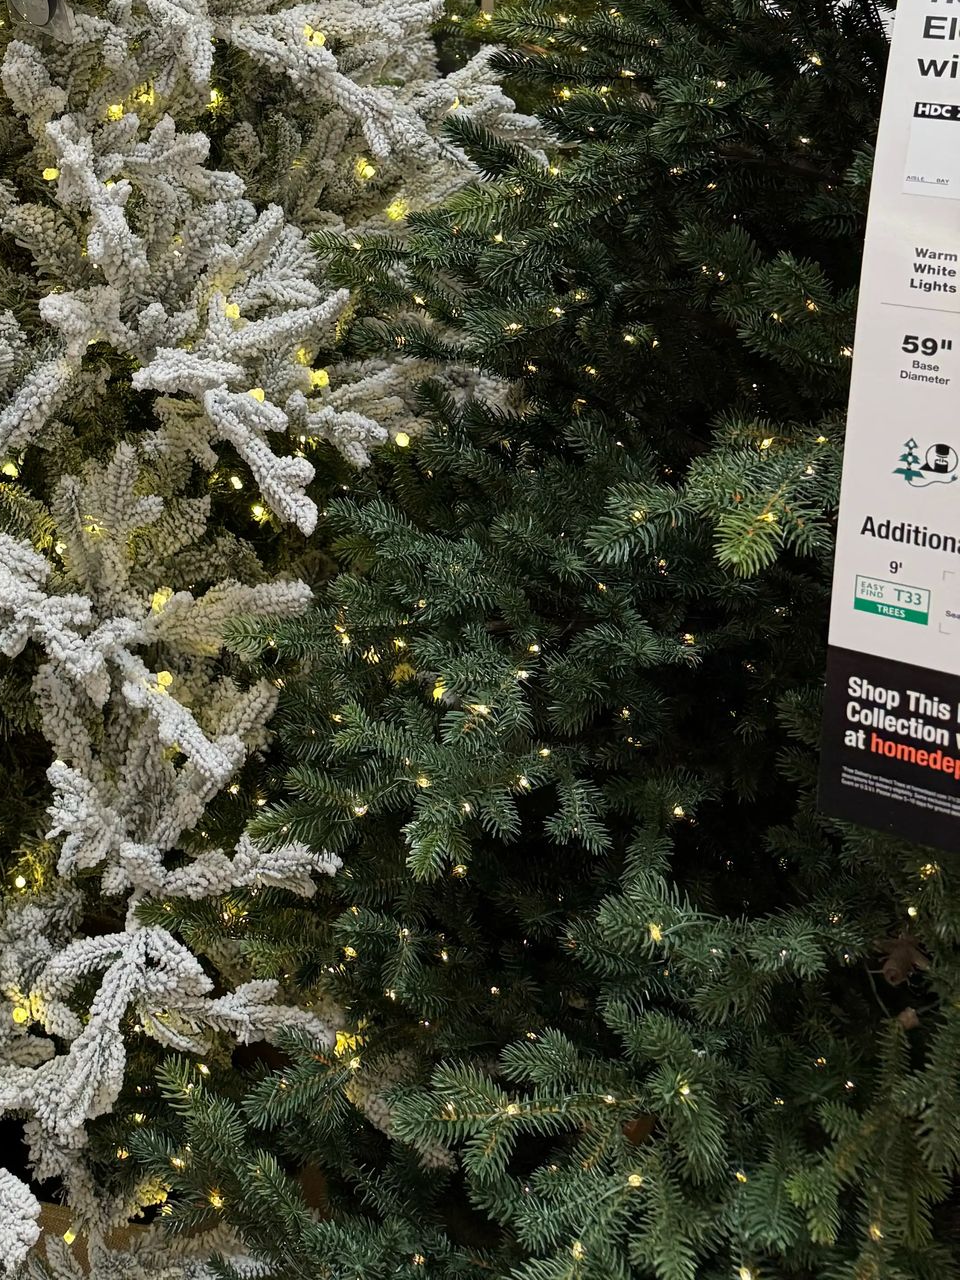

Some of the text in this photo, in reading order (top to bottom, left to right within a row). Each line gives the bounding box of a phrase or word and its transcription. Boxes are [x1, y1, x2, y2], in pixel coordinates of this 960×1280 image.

[918, 104, 952, 117] HDC
[915, 247, 958, 262] Warm
[913, 263, 957, 277] White
[910, 278, 957, 293] Lights
[901, 334, 952, 356] 59"
[912, 360, 939, 371] Base
[900, 370, 950, 385] Diameter
[889, 561, 902, 574] 9'
[861, 581, 885, 591] EASY
[861, 588, 922, 605] FIND T33
[877, 604, 906, 618] TREES
[847, 676, 951, 720] Shop This
[846, 701, 949, 747] Collection
[844, 729, 866, 750] at
